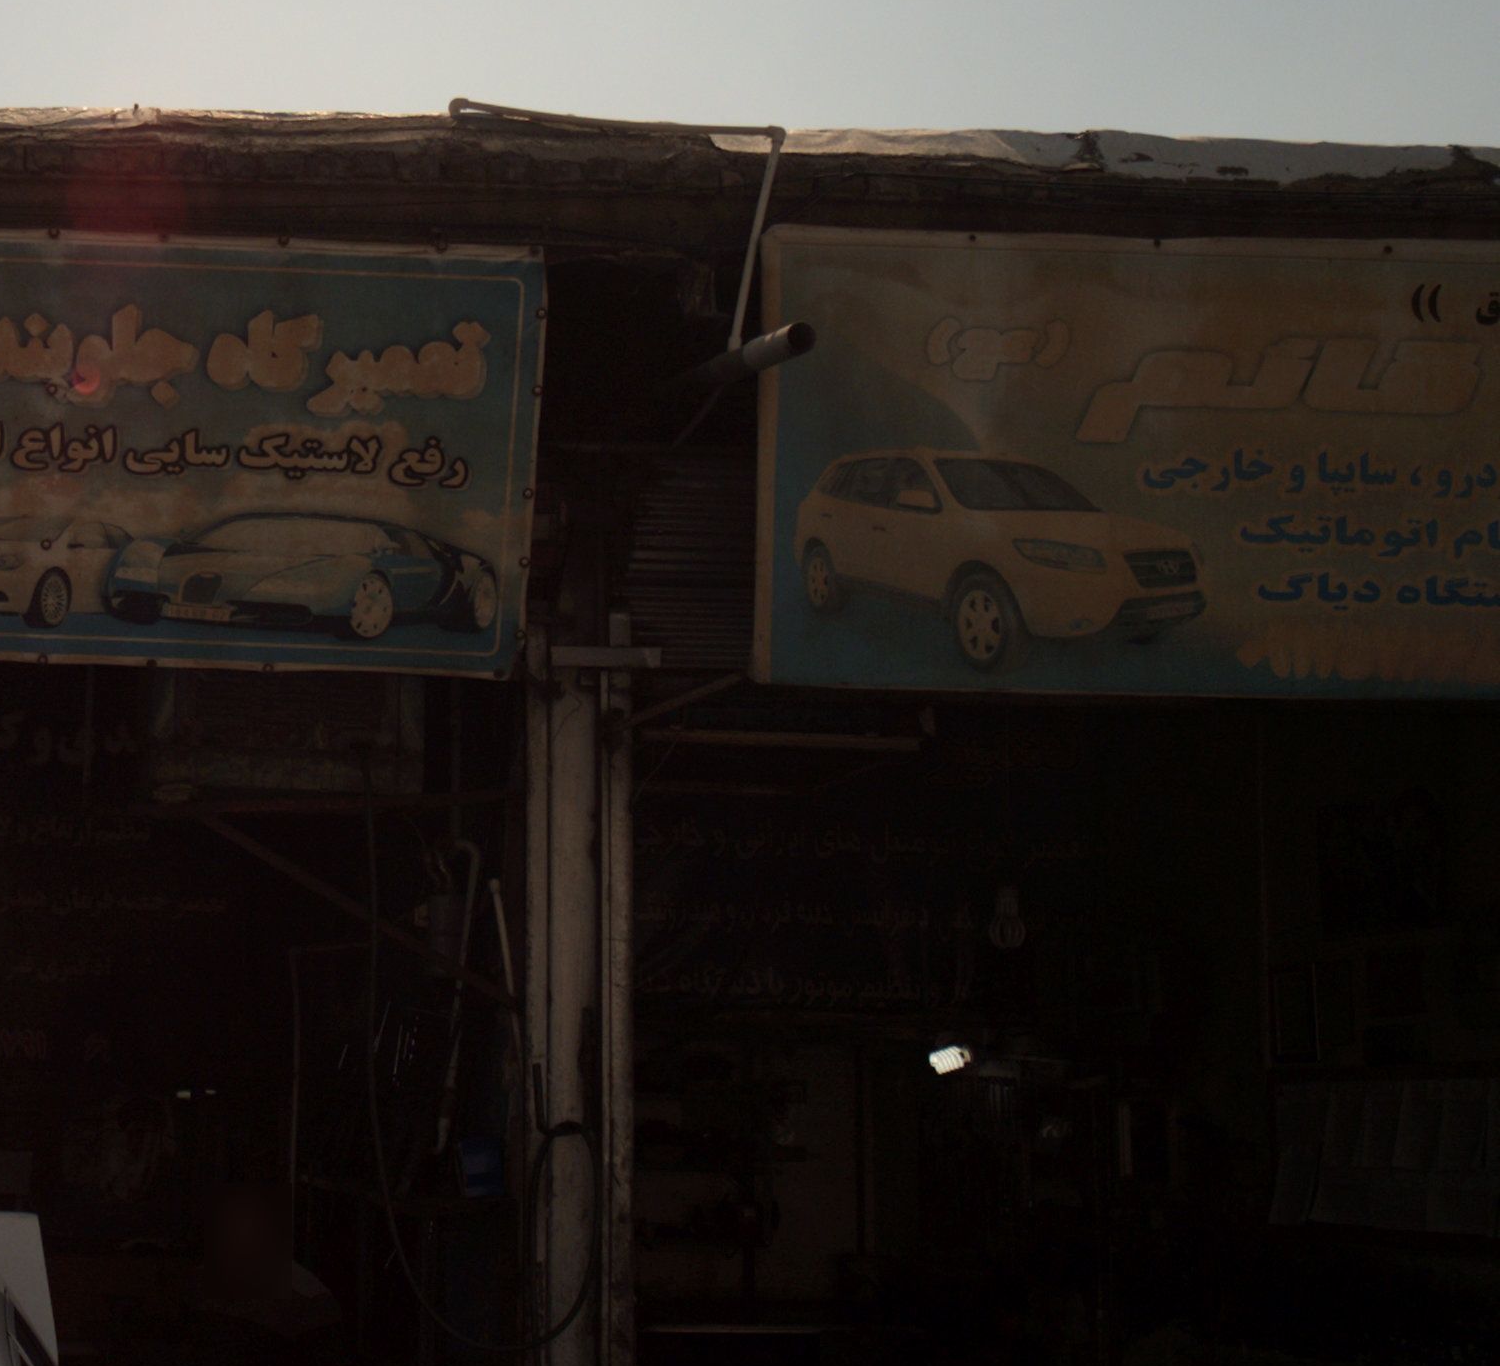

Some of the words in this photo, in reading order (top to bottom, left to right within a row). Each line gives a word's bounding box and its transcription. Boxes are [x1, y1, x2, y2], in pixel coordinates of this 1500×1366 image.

[12, 423, 118, 473] انواع
[123, 420, 229, 475] سایی
[237, 432, 381, 479] لاستیک
[389, 436, 470, 488] رفع
[1142, 447, 1274, 492] خارجی
[1285, 465, 1306, 493] و
[1317, 449, 1398, 496] سایپا
[1240, 514, 1438, 557] اتوماتیک
